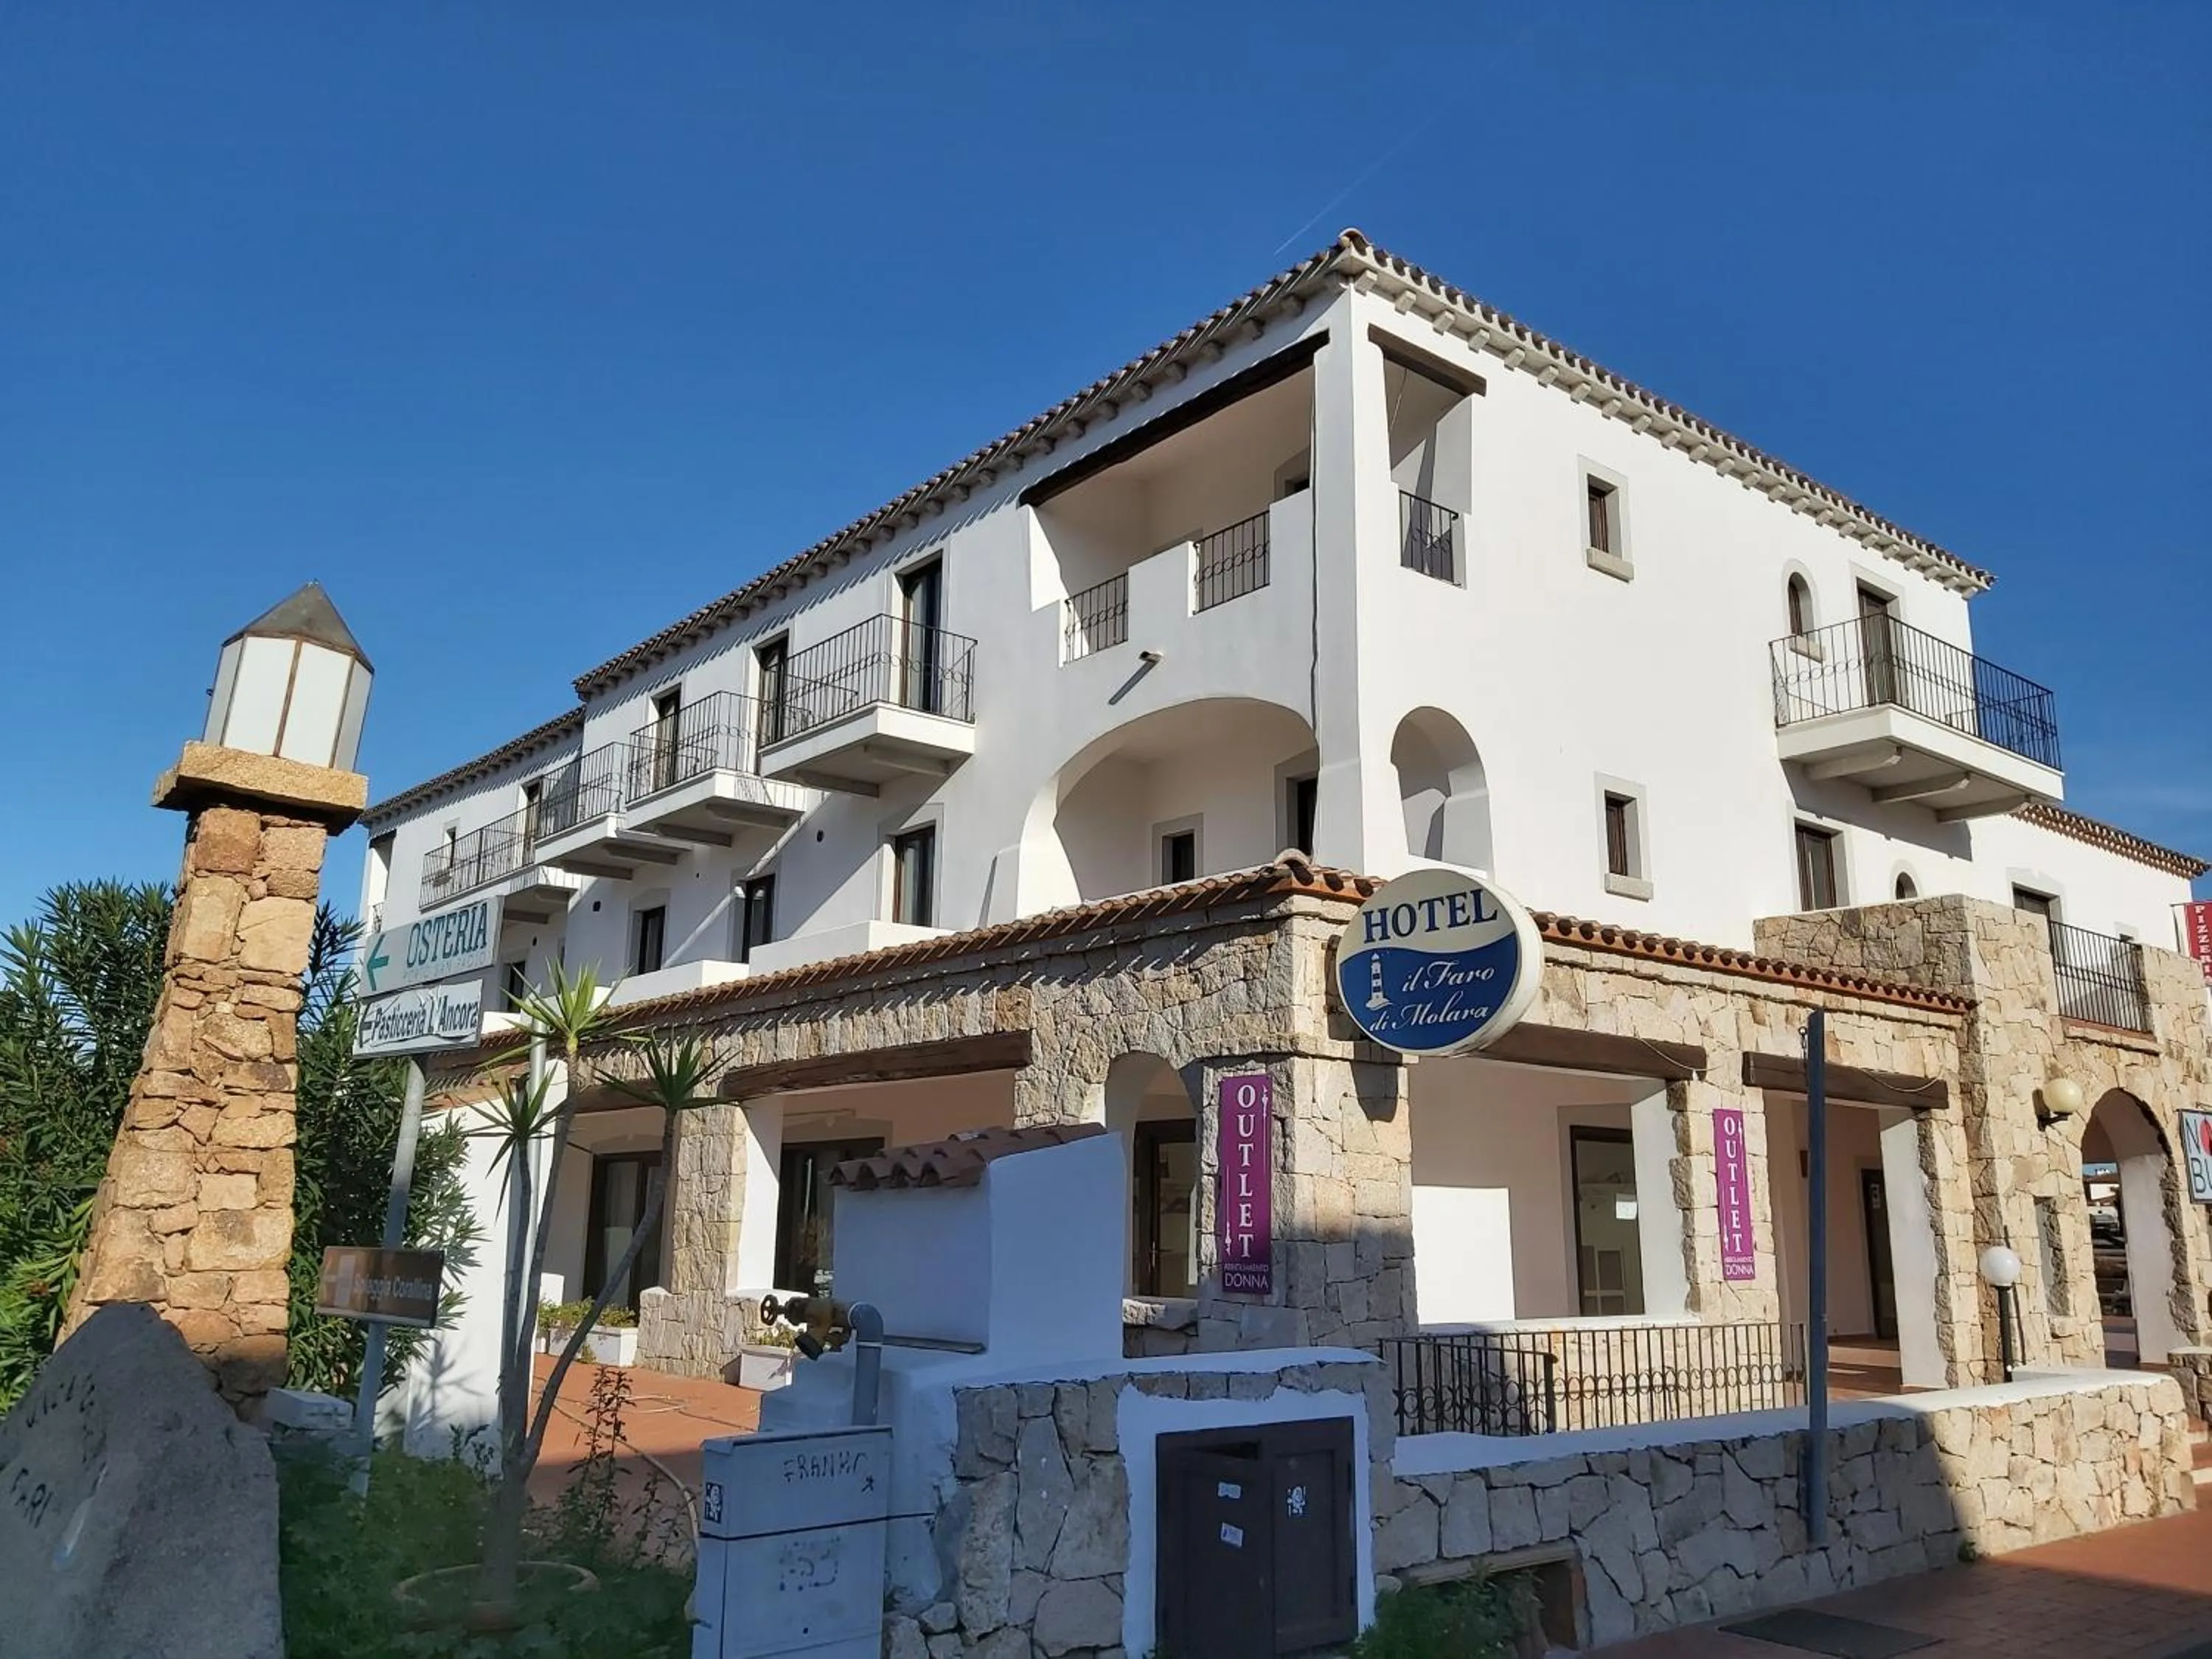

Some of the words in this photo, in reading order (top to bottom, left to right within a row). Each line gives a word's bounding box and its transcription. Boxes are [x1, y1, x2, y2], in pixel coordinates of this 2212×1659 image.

[406, 902, 487, 968] OSTERIA
[1362, 888, 1498, 944] HOTEL
[1402, 967, 1422, 992] il
[1425, 961, 1495, 990] Faro
[1368, 1011, 1388, 1032] di
[1392, 990, 1487, 1029] Molara
[1236, 1085, 1255, 1258] OUTLET
[1723, 1116, 1742, 1253] OUTLET
[1224, 1273, 1269, 1289] DONNA
[1725, 1263, 1754, 1276] DONNA
